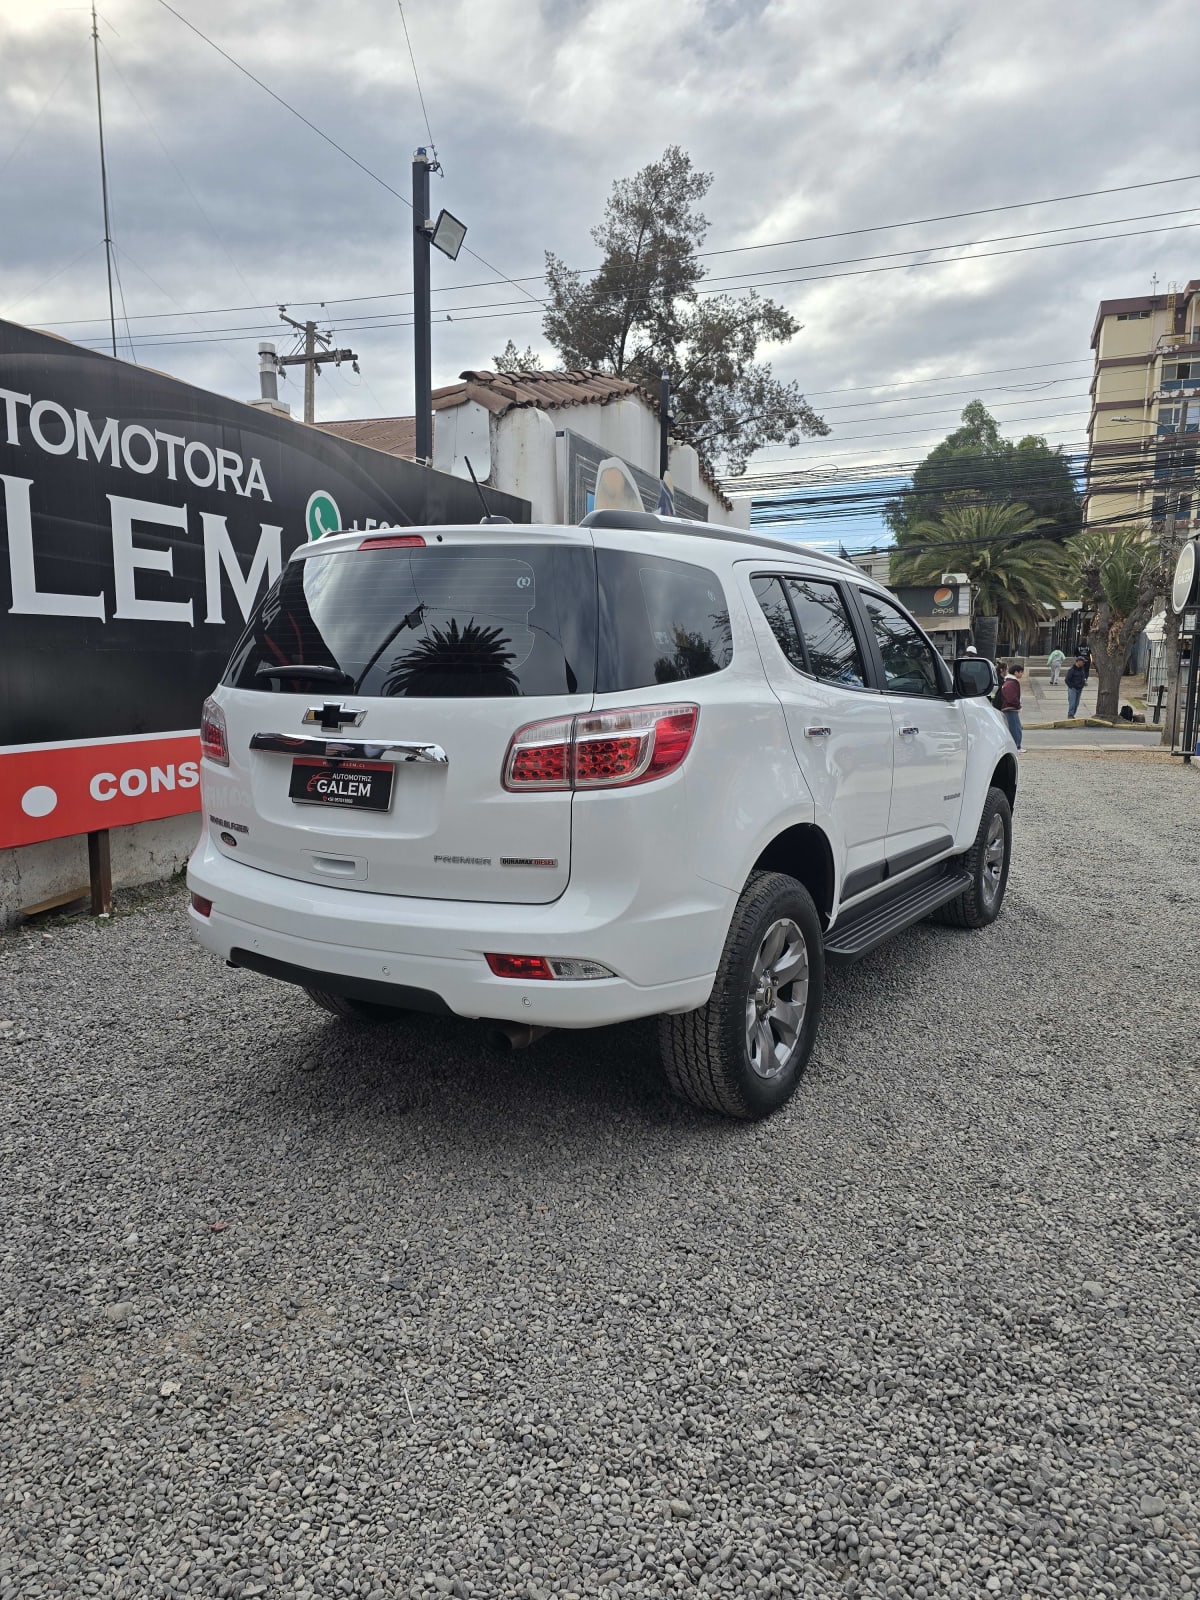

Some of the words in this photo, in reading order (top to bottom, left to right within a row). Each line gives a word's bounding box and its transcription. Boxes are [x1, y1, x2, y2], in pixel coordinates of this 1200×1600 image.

[932, 607, 955, 615] pepsi
[89, 761, 200, 801] CONS
[332, 773, 372, 782] AUTOMOTRIZ
[316, 780, 372, 797] GALEM
[433, 855, 491, 865] PREMIER
